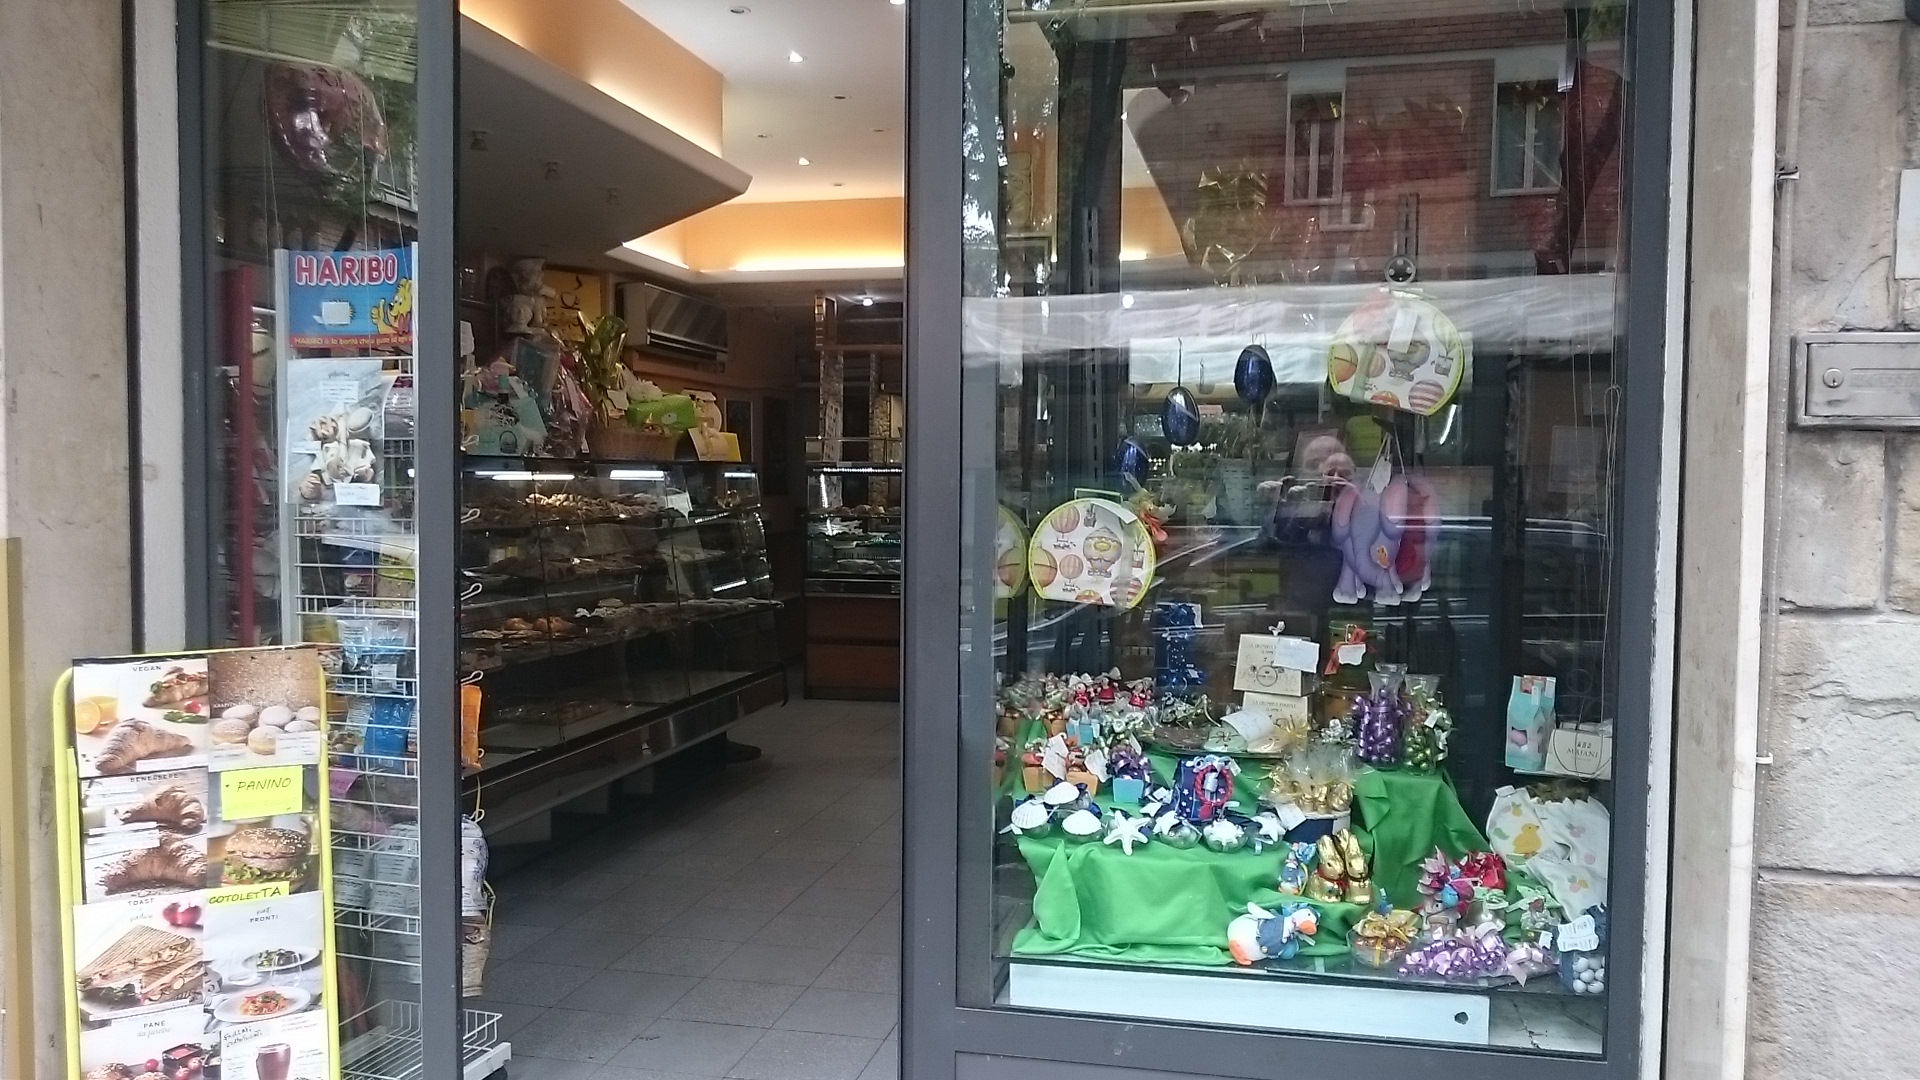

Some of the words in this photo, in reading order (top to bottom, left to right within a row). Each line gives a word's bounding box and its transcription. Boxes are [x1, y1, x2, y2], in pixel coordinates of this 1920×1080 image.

[295, 252, 398, 286] HARIBO
[237, 778, 291, 792] PANINO
[128, 897, 154, 906] TOAST
[208, 886, 281, 904] COTOLETTA
[143, 1020, 166, 1028] PANE
